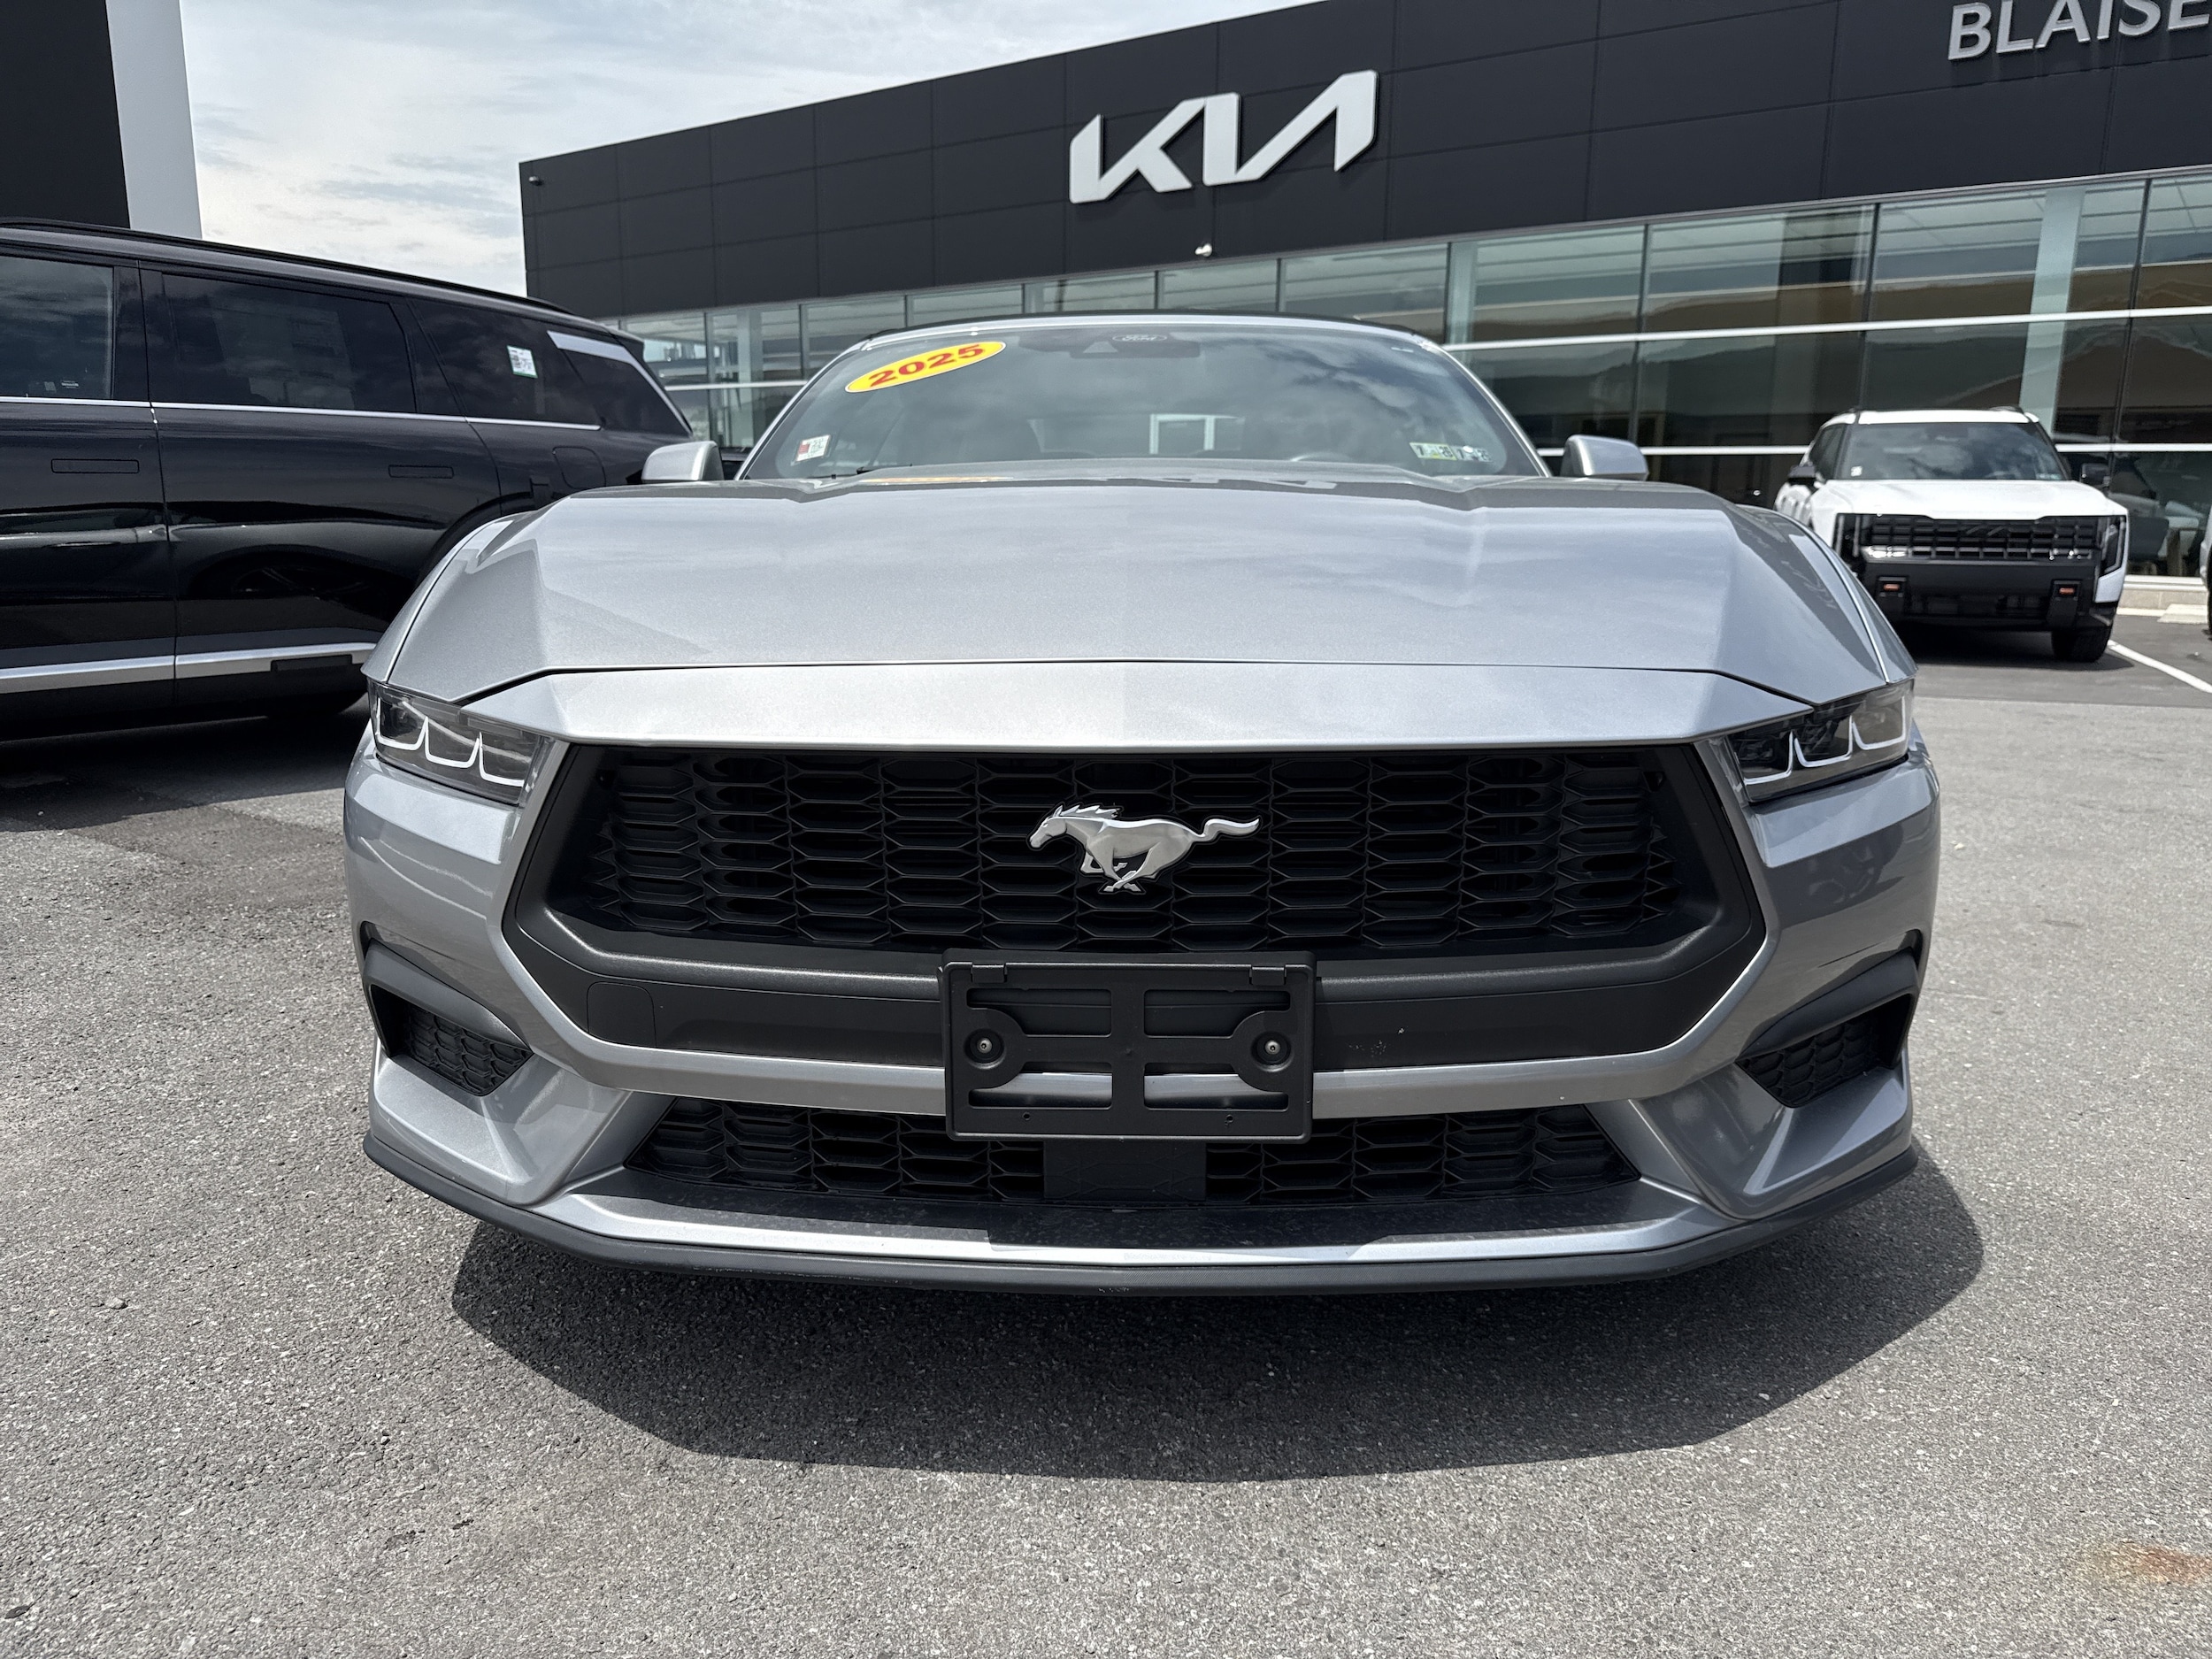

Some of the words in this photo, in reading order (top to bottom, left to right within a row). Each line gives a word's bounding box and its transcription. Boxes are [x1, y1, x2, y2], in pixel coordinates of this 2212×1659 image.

[1948, 0, 2210, 60] BLAISE
[1070, 69, 1378, 204] KIA
[868, 343, 984, 387] 2025
